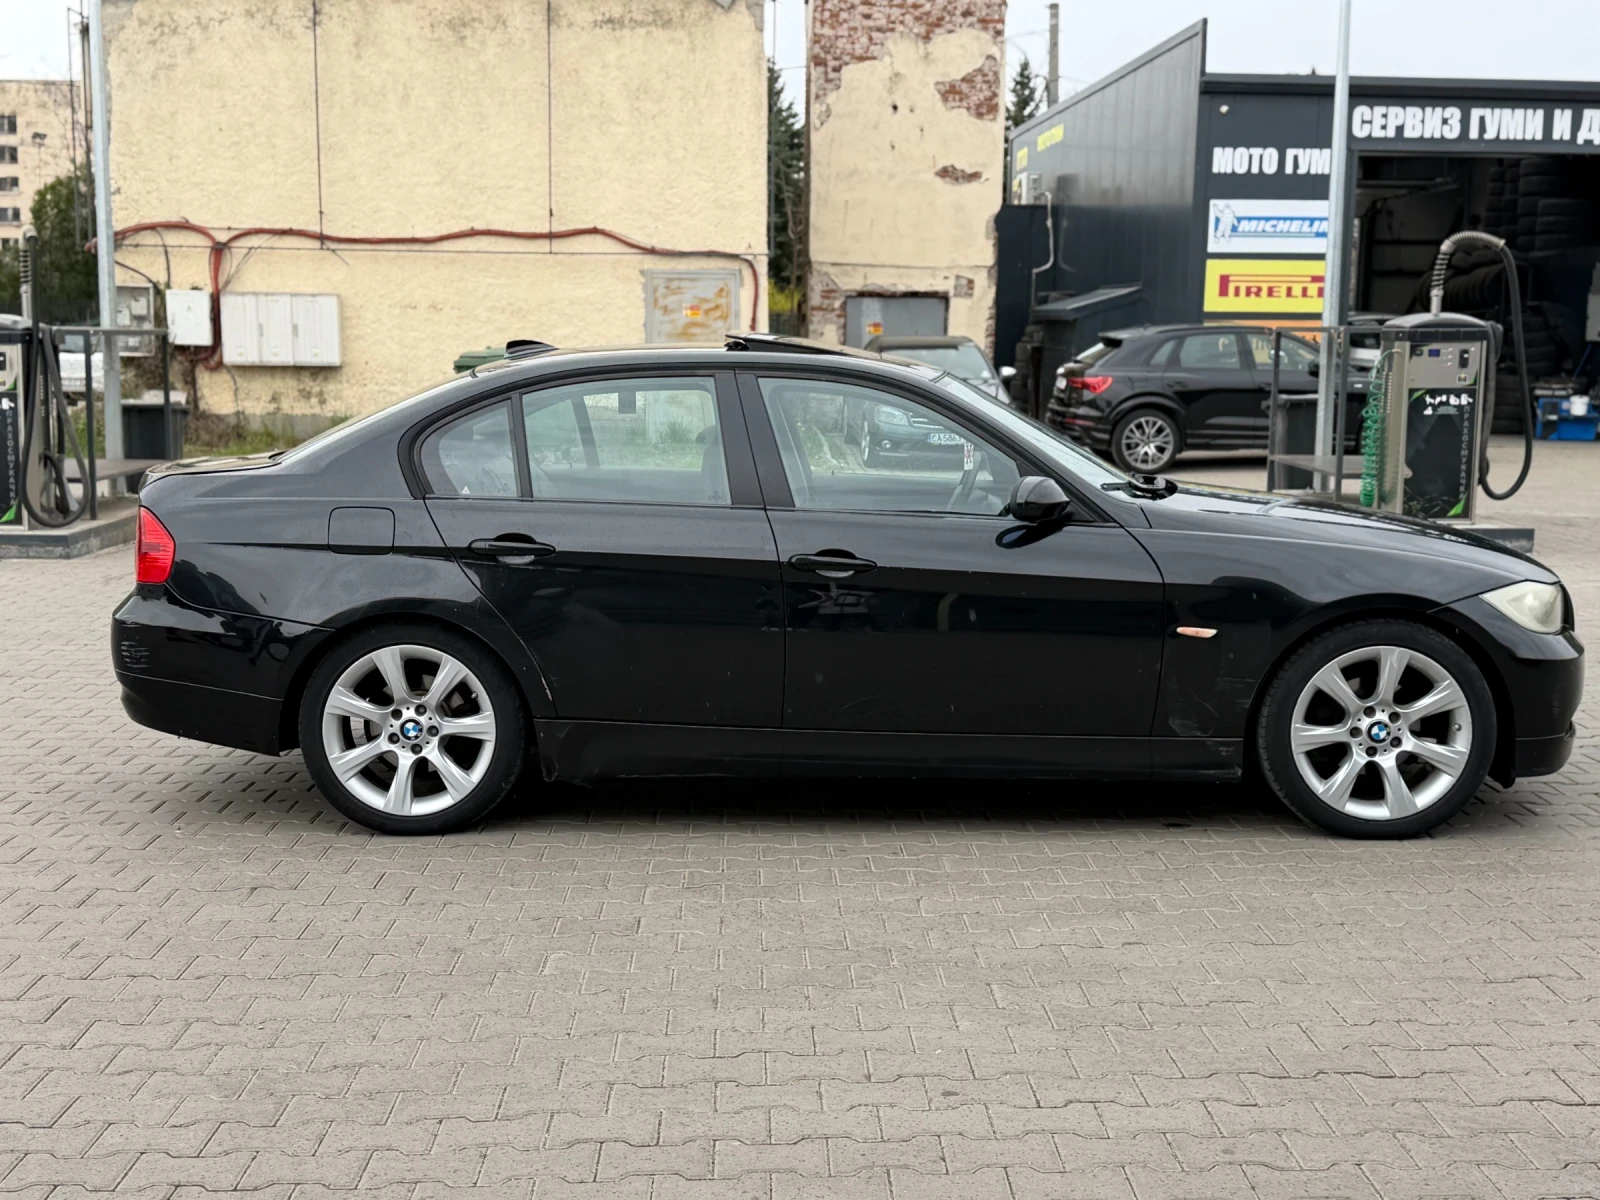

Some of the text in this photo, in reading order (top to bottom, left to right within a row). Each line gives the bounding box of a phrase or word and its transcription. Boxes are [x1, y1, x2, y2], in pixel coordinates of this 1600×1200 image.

[1351, 105, 1462, 139] СЕРВИЗ
[1469, 107, 1544, 141] ГУМИ
[1552, 108, 1572, 141] И
[1212, 147, 1279, 174] МОТО
